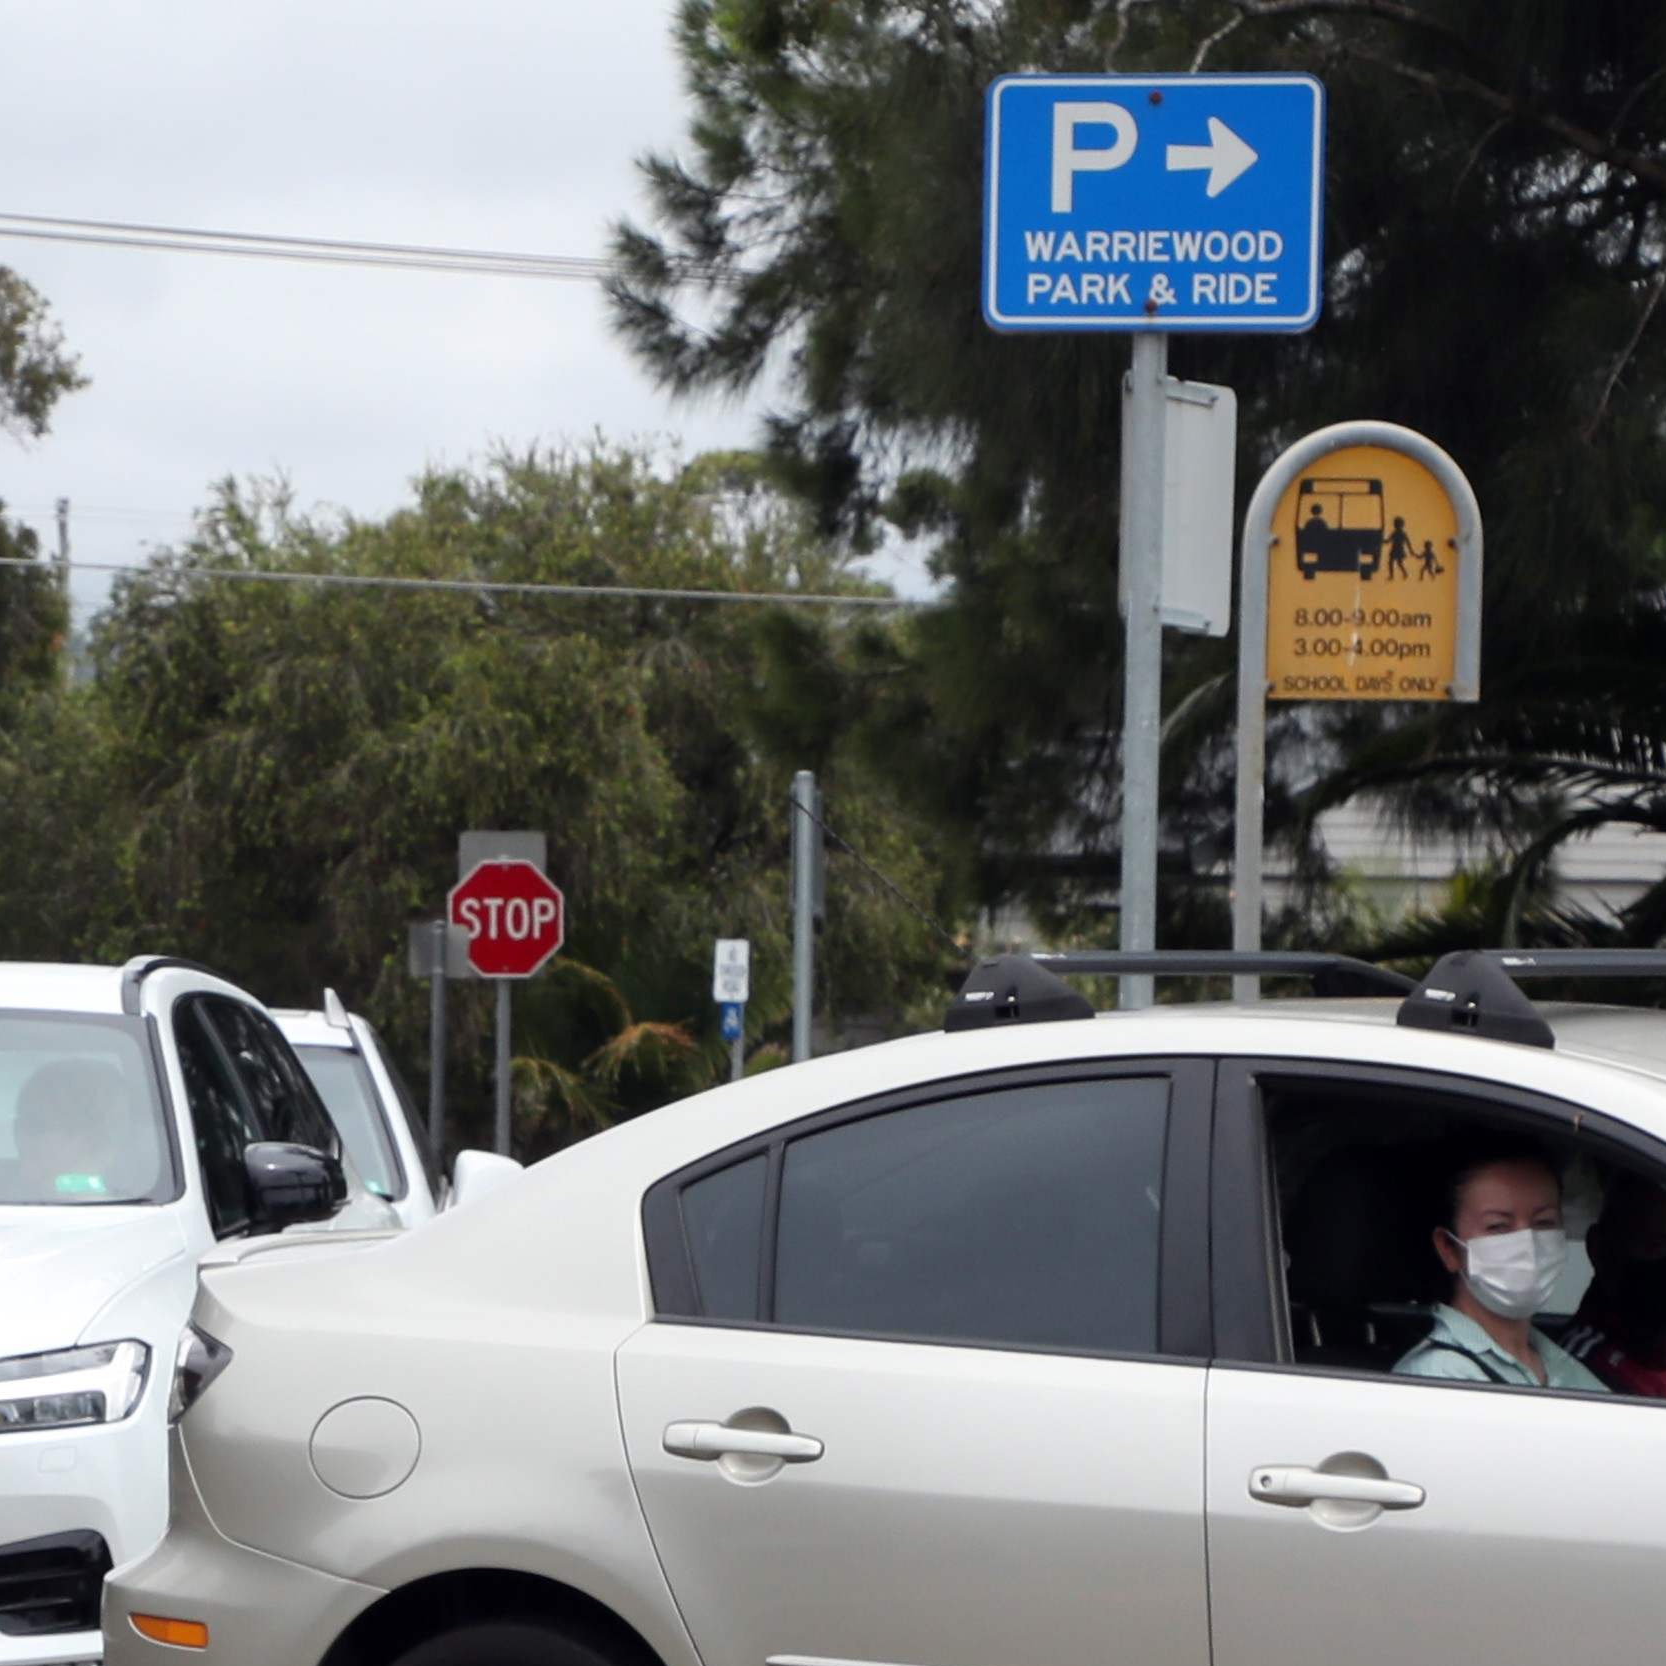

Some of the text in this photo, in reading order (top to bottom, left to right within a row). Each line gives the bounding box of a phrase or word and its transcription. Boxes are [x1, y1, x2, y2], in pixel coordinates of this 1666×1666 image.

[1051, 101, 1139, 213] P
[1024, 229, 1284, 263] WARRIEWOOD
[1027, 272, 1278, 306] PARK & RIDE
[1294, 607, 1432, 627] 8.00-9.00am
[1294, 637, 1431, 660] 3.00-4.00pm
[1284, 674, 1439, 692] SCHOOL DAYS ONLY
[460, 897, 556, 940] STOP
